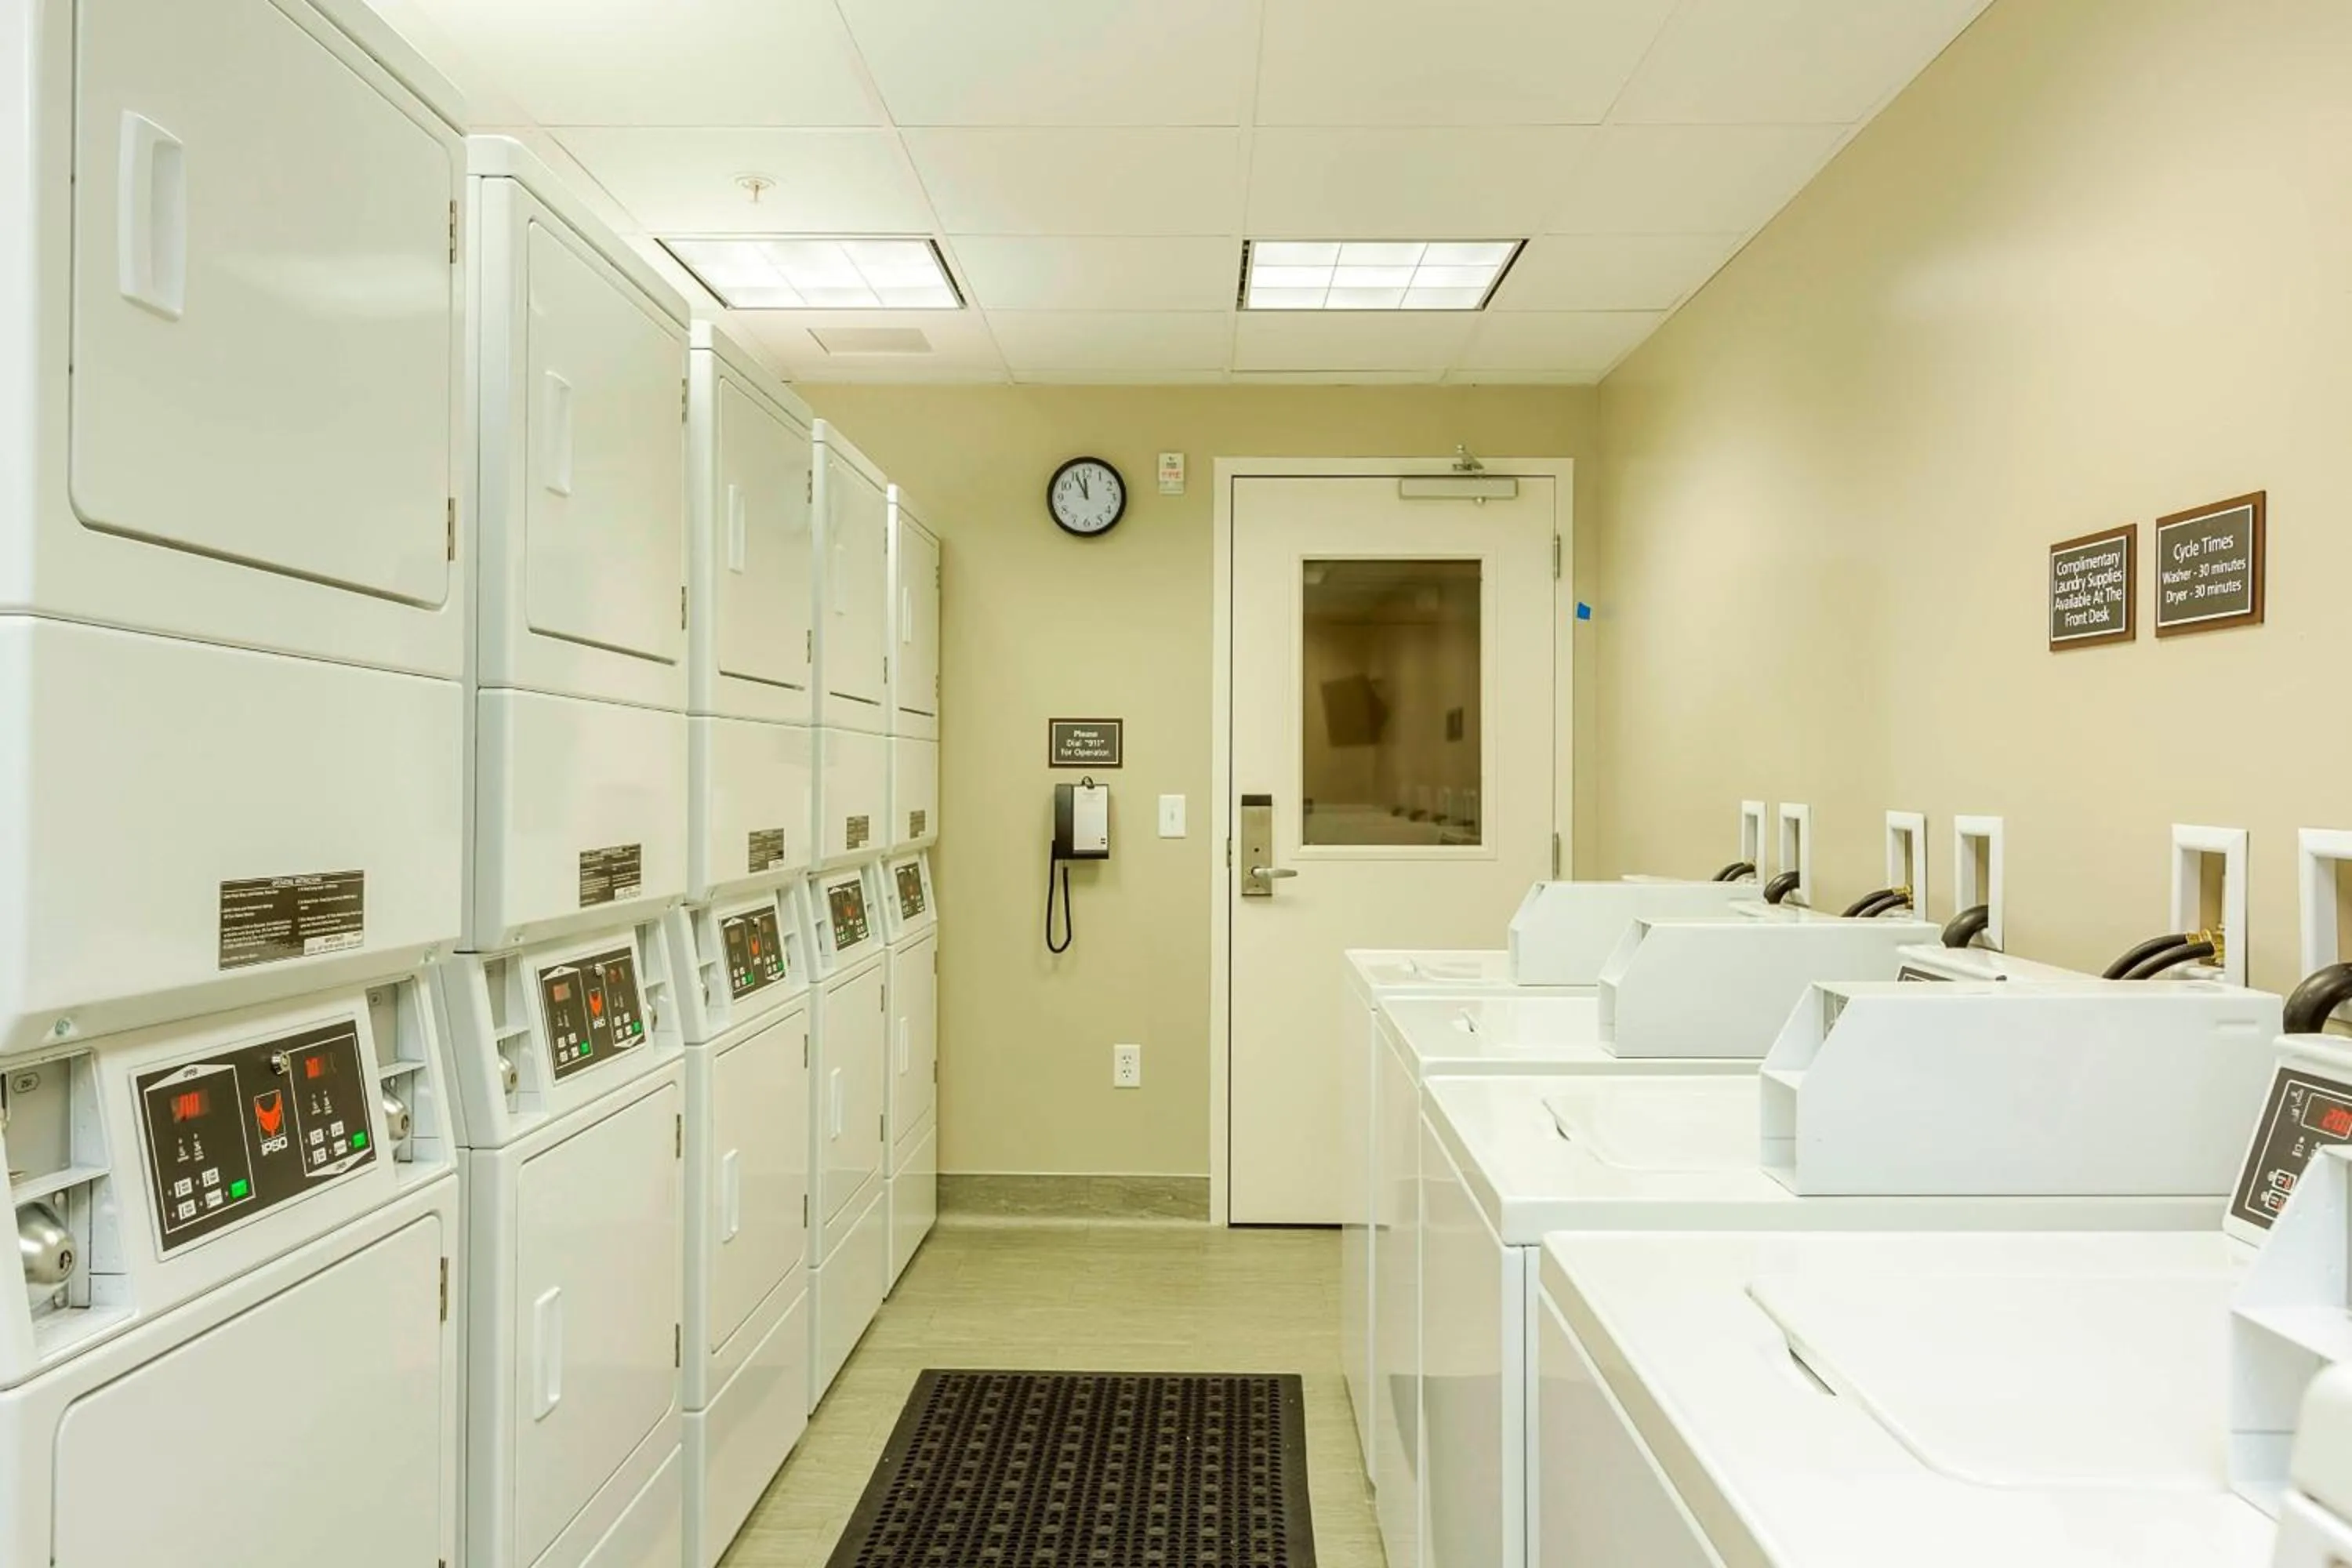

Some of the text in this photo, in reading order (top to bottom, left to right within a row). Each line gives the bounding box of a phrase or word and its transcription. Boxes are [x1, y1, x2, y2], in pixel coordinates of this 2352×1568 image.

[2173, 535, 2234, 564] Cycle Times
[2056, 552, 2121, 576] Complimentary
[2162, 569, 2191, 584] Washer
[2198, 563, 2209, 578] 30
[2211, 558, 2246, 575] minutes
[2055, 568, 2122, 593] Laundry Supplies
[2166, 590, 2188, 605] Dryer
[2195, 584, 2205, 598] 30
[2207, 580, 2242, 596] minutes
[2055, 586, 2122, 610] Available At The
[2065, 605, 2110, 627] Front Desk
[1073, 729, 1098, 738] Please
[261, 1136, 288, 1156] IPSO
